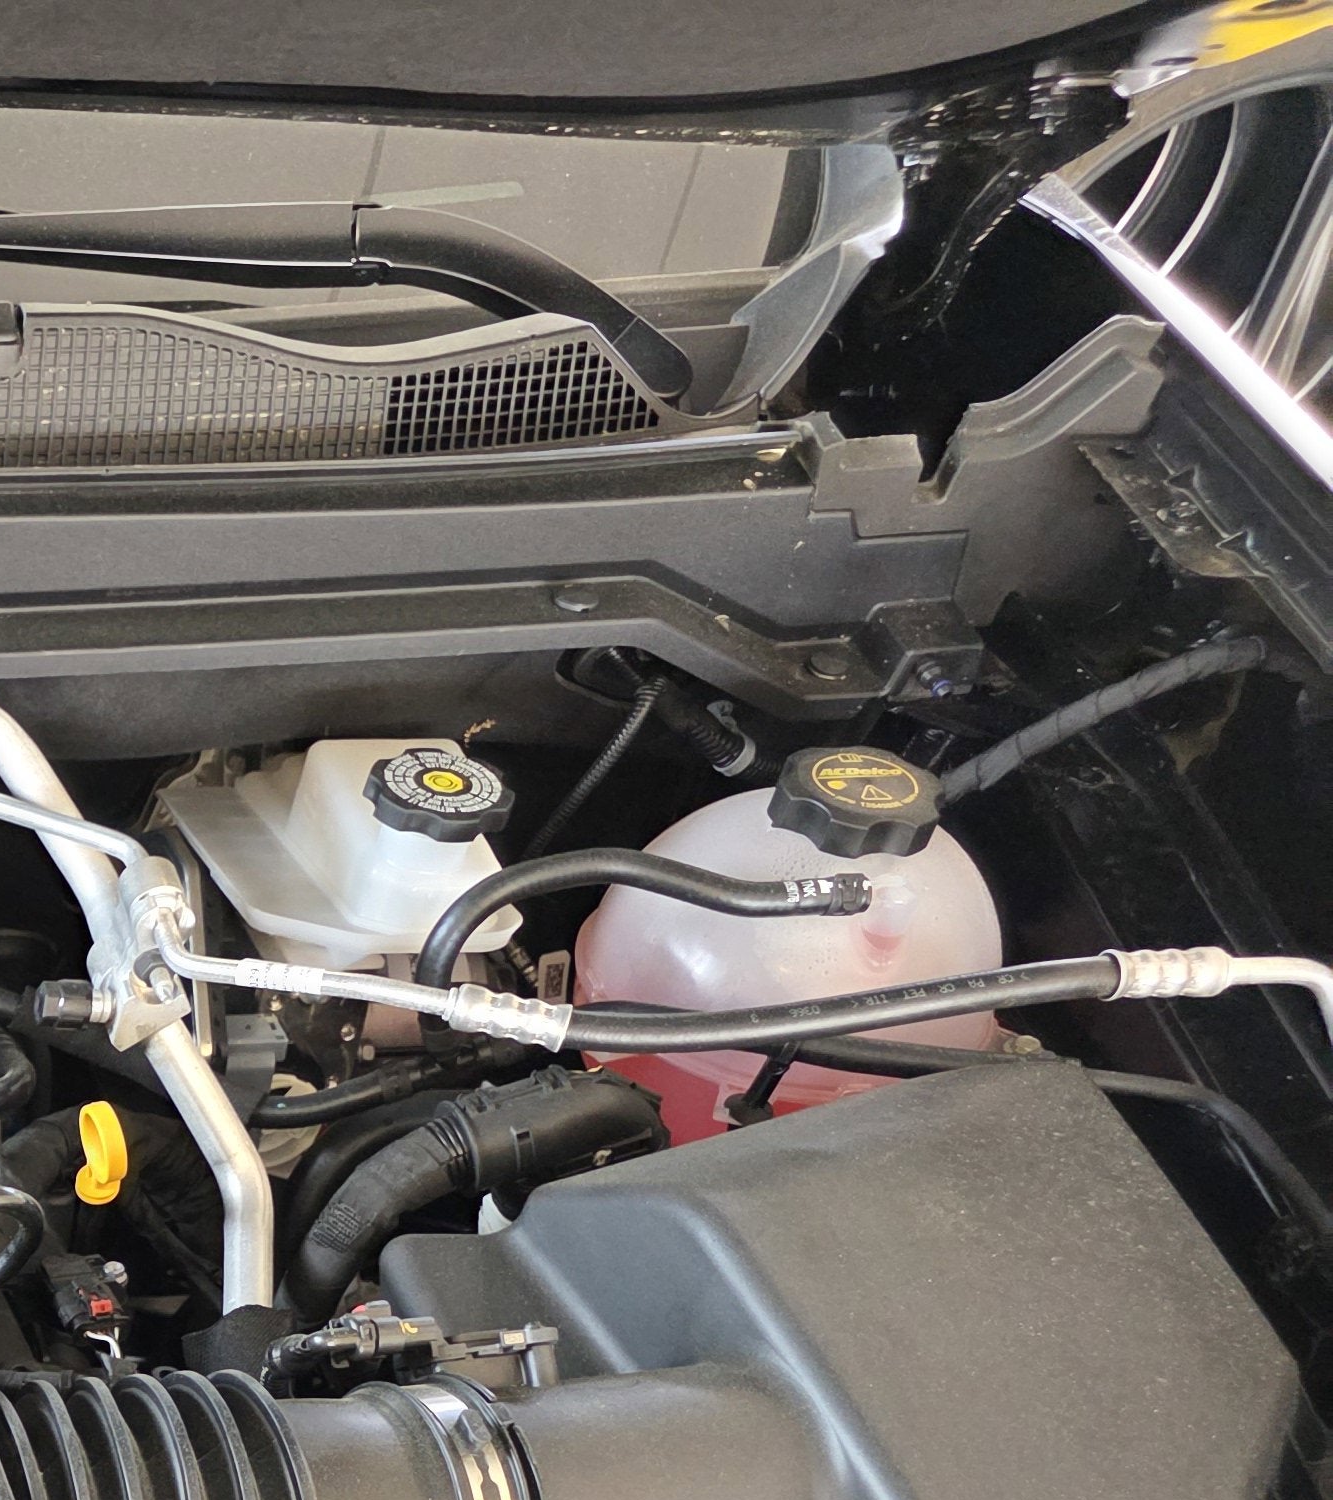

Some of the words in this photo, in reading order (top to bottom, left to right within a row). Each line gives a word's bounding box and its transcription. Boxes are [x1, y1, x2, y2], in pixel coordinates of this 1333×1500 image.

[819, 767, 902, 778] ACDelco
[968, 978, 985, 989] PA
[902, 987, 927, 999] PET
